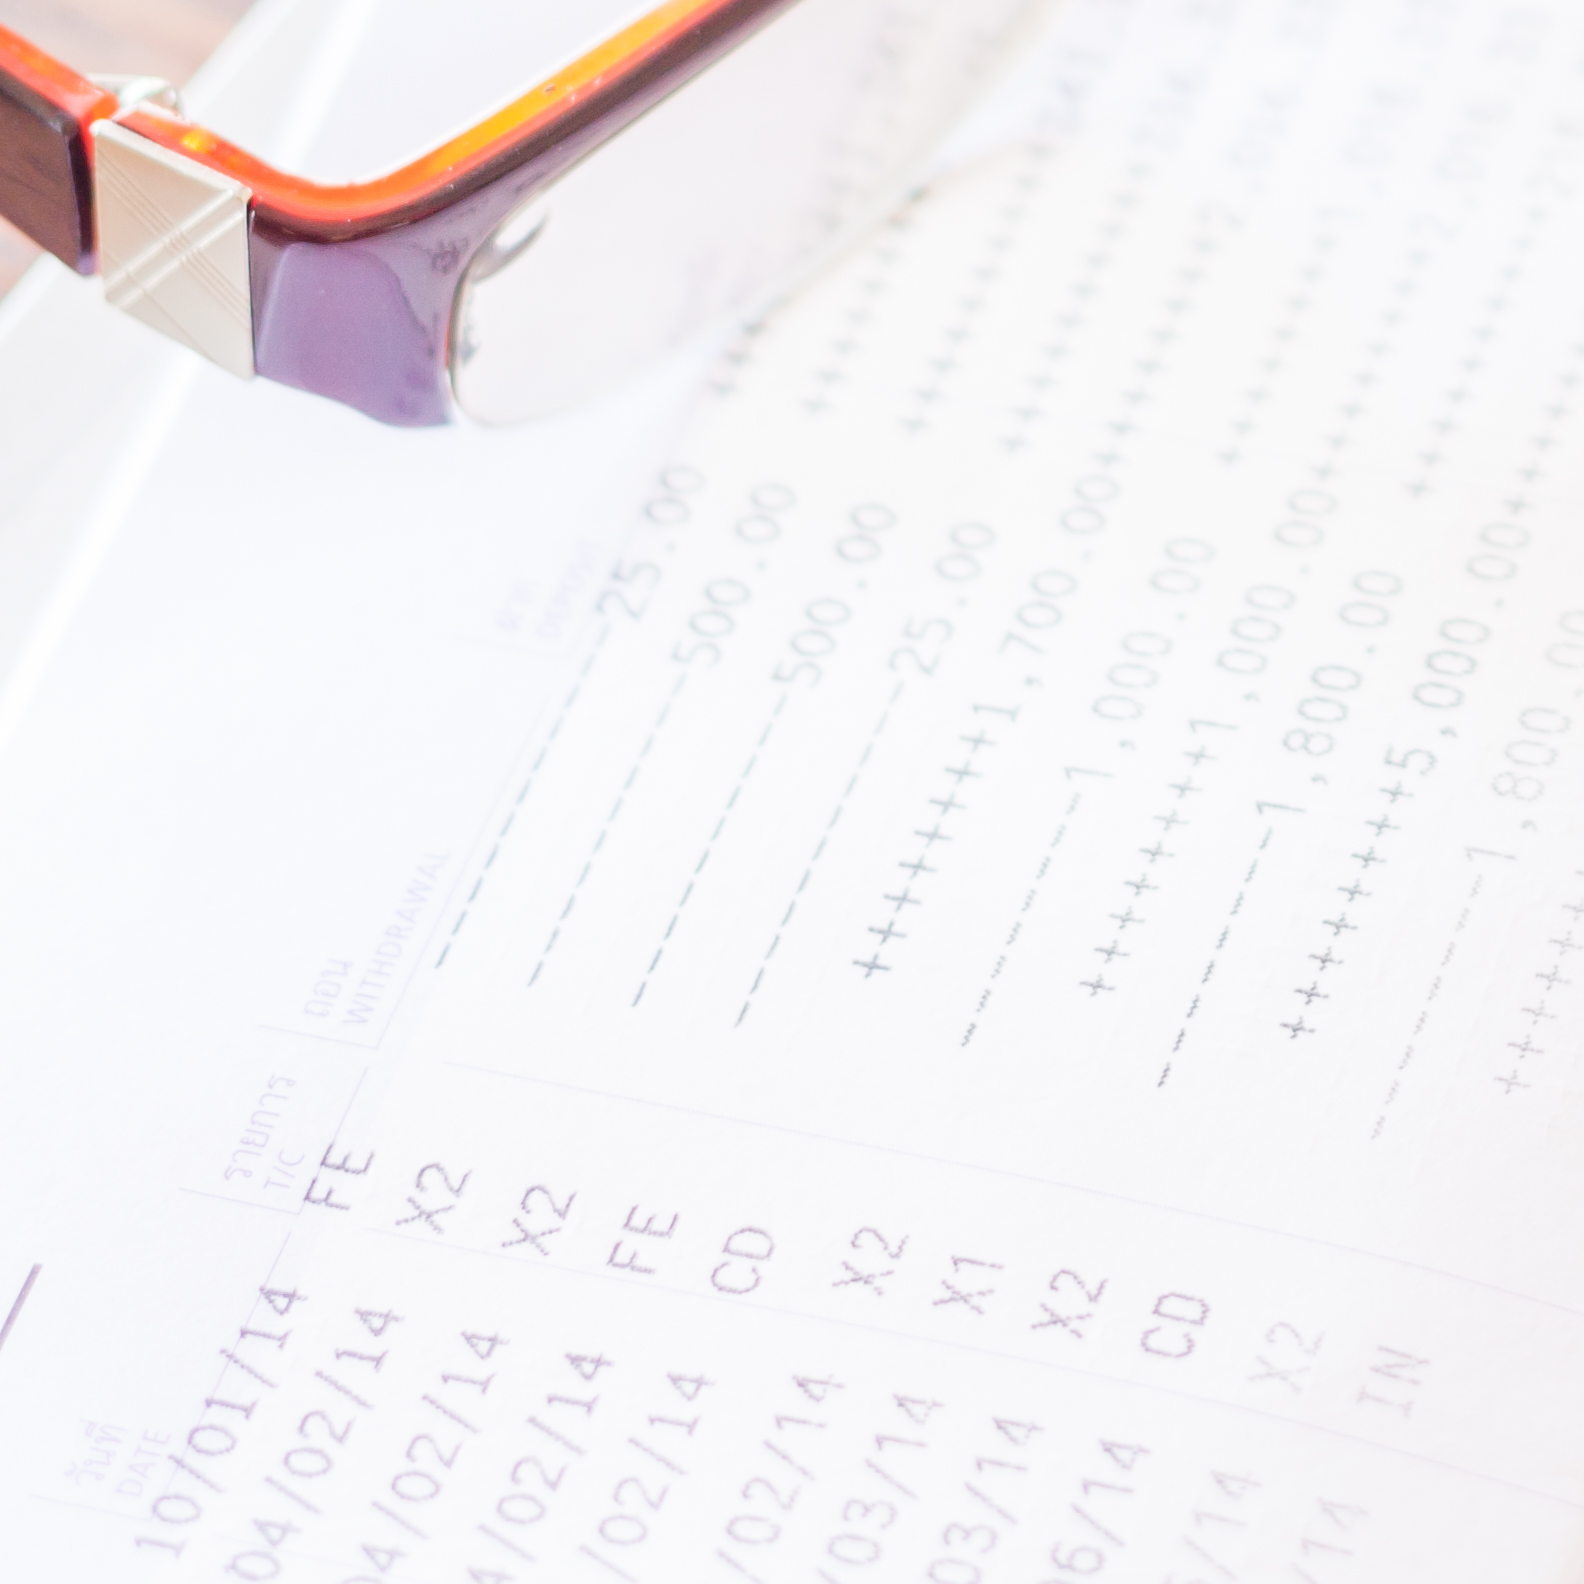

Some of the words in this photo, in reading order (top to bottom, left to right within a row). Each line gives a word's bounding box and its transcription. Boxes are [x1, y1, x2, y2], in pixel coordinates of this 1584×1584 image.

[341, 849, 452, 1028] WITHDRAWAL
[501, 1183, 579, 1258] X2
[606, 1203, 681, 1277] FE
[710, 1224, 777, 1296] CD
[831, 1225, 911, 1298] X2
[932, 1254, 1006, 1316] X1
[1031, 1268, 1109, 1340] X2
[1140, 1291, 1212, 1359] CD
[134, 1284, 308, 1558] 10/01/14
[302, 1140, 377, 1212] FE
[222, 1307, 406, 1582] 04/02/14
[395, 1161, 473, 1235] X2
[1247, 1319, 1326, 1395] X2
[1356, 1344, 1433, 1419] IN
[114, 1427, 172, 1498] DATE
